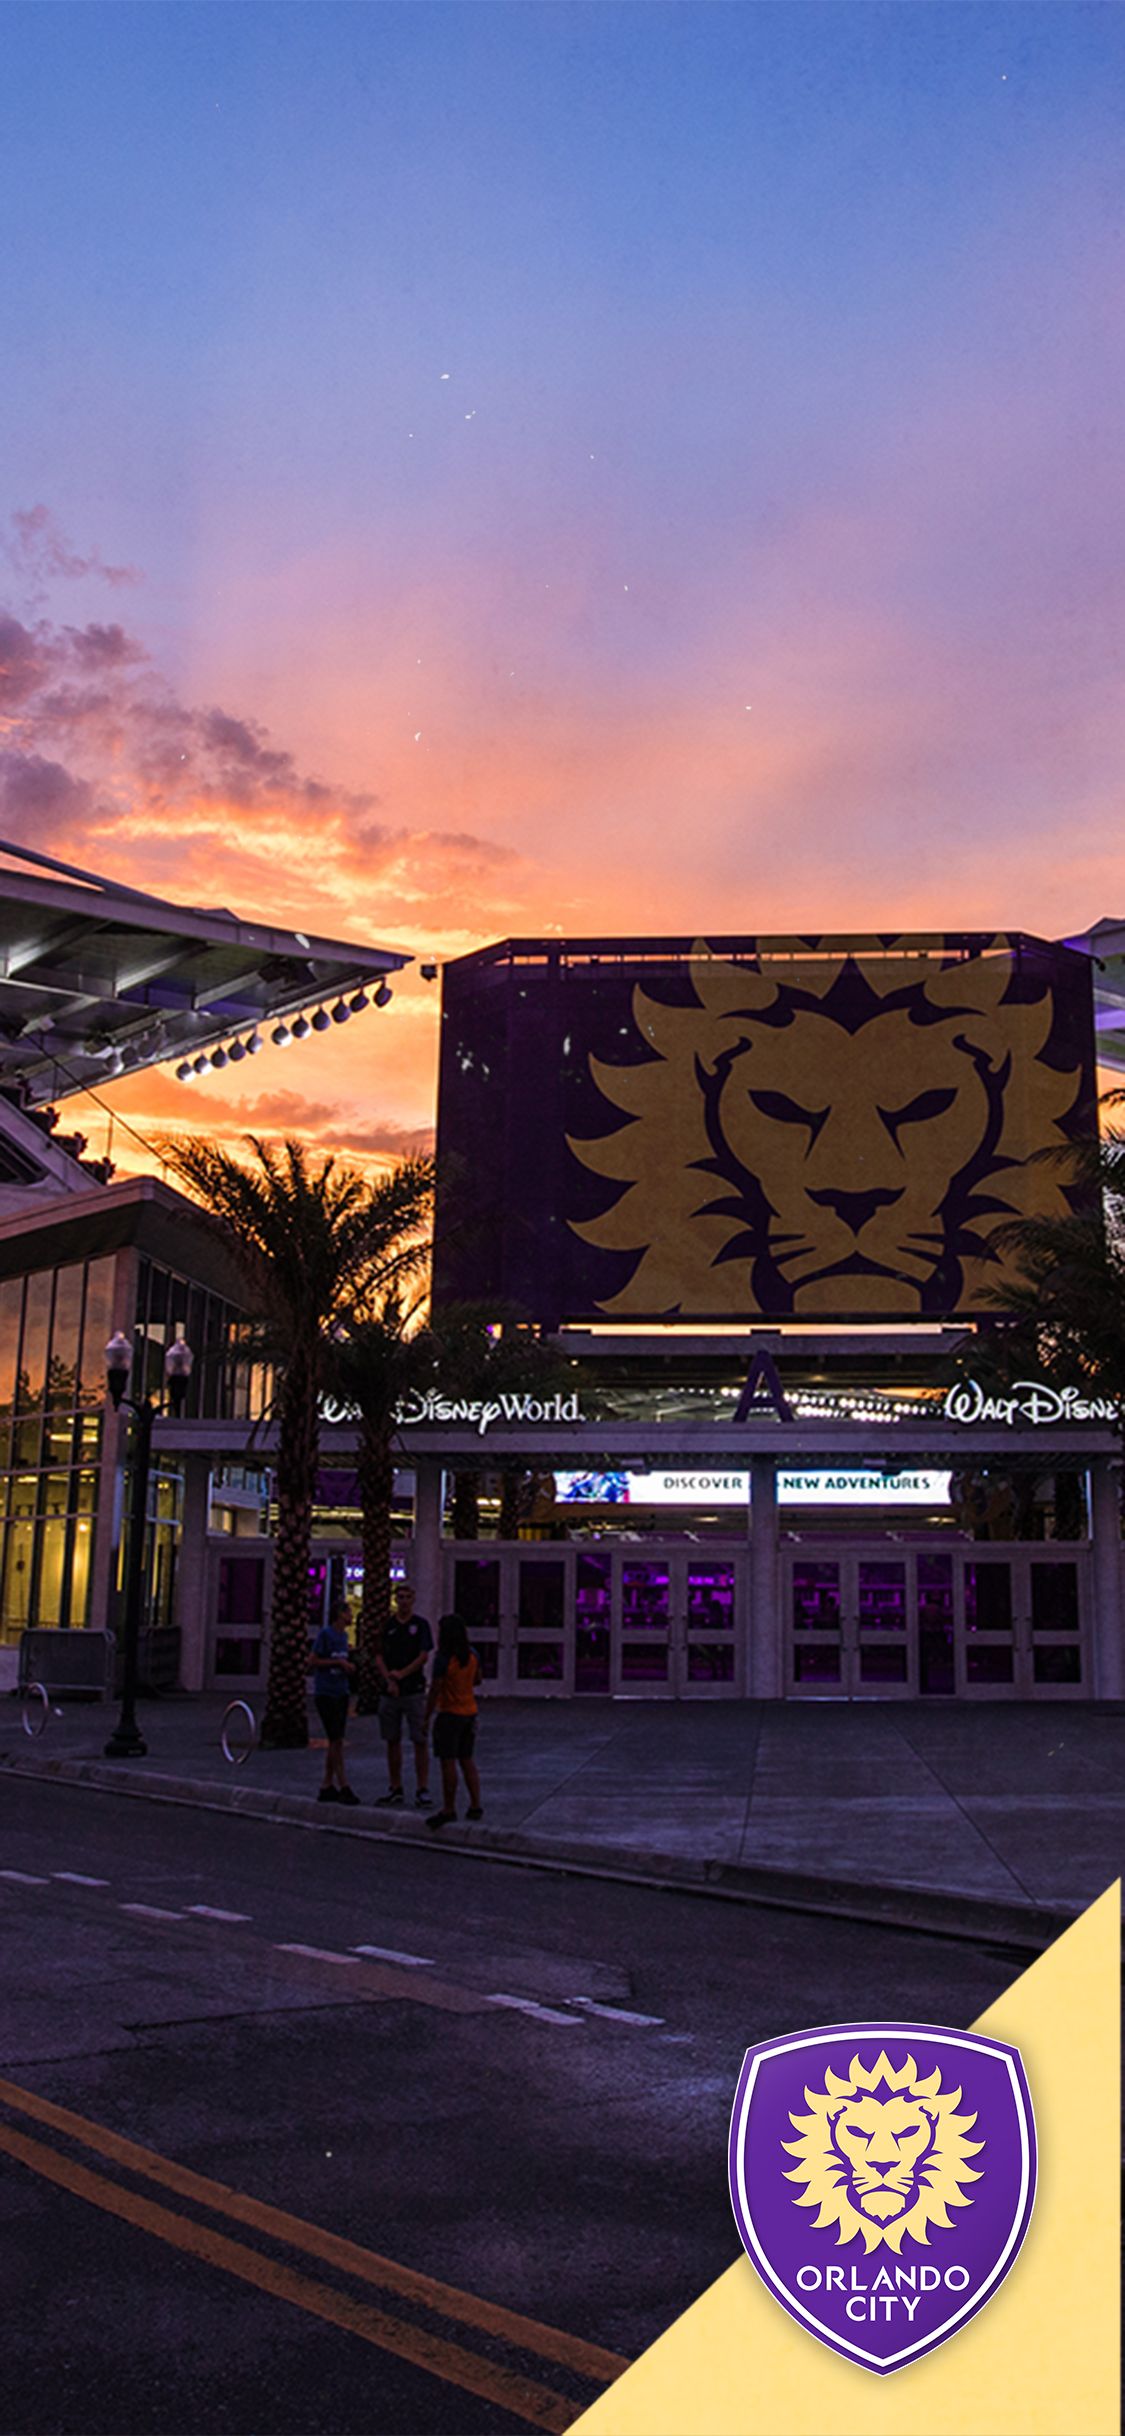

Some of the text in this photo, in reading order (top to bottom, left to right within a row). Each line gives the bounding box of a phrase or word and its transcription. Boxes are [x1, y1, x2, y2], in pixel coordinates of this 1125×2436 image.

[732, 1350, 795, 1423] A
[663, 1477, 931, 1490] DISCOVER NEW ADVENTURES
